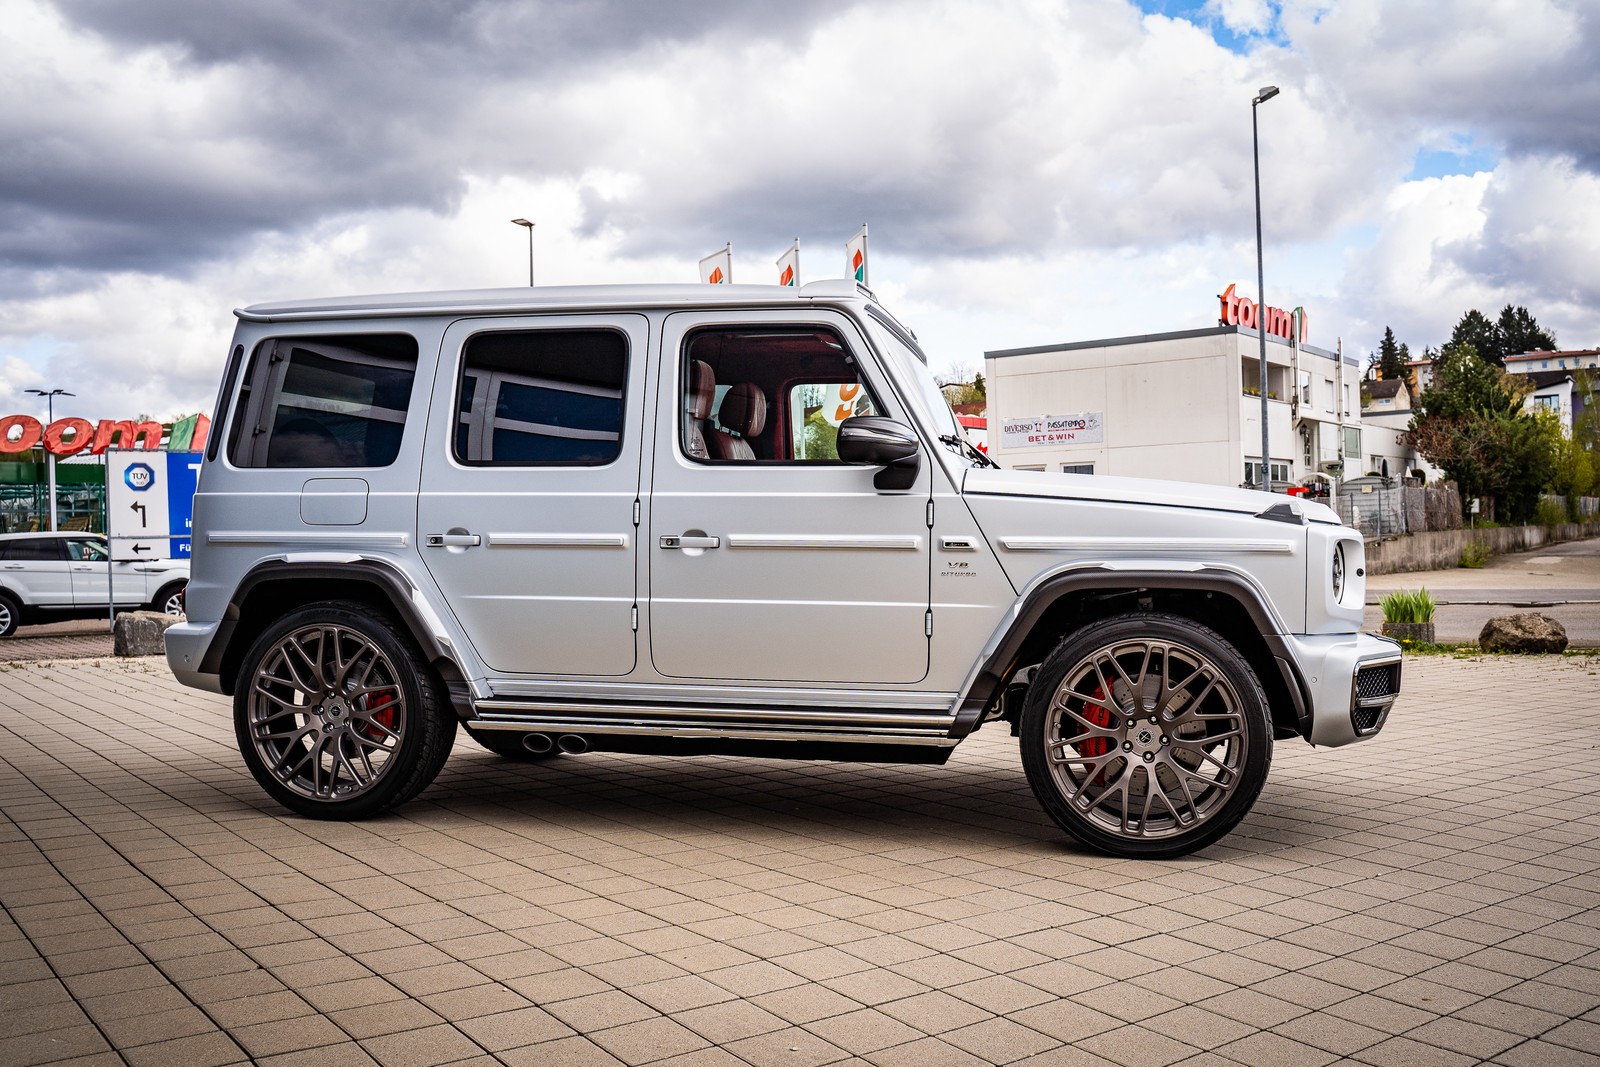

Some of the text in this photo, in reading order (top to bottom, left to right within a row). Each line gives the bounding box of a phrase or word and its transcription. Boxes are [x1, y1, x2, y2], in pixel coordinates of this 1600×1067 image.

[1221, 283, 1292, 340] toom
[1028, 434, 1047, 443] BET
[948, 561, 969, 569] V8
